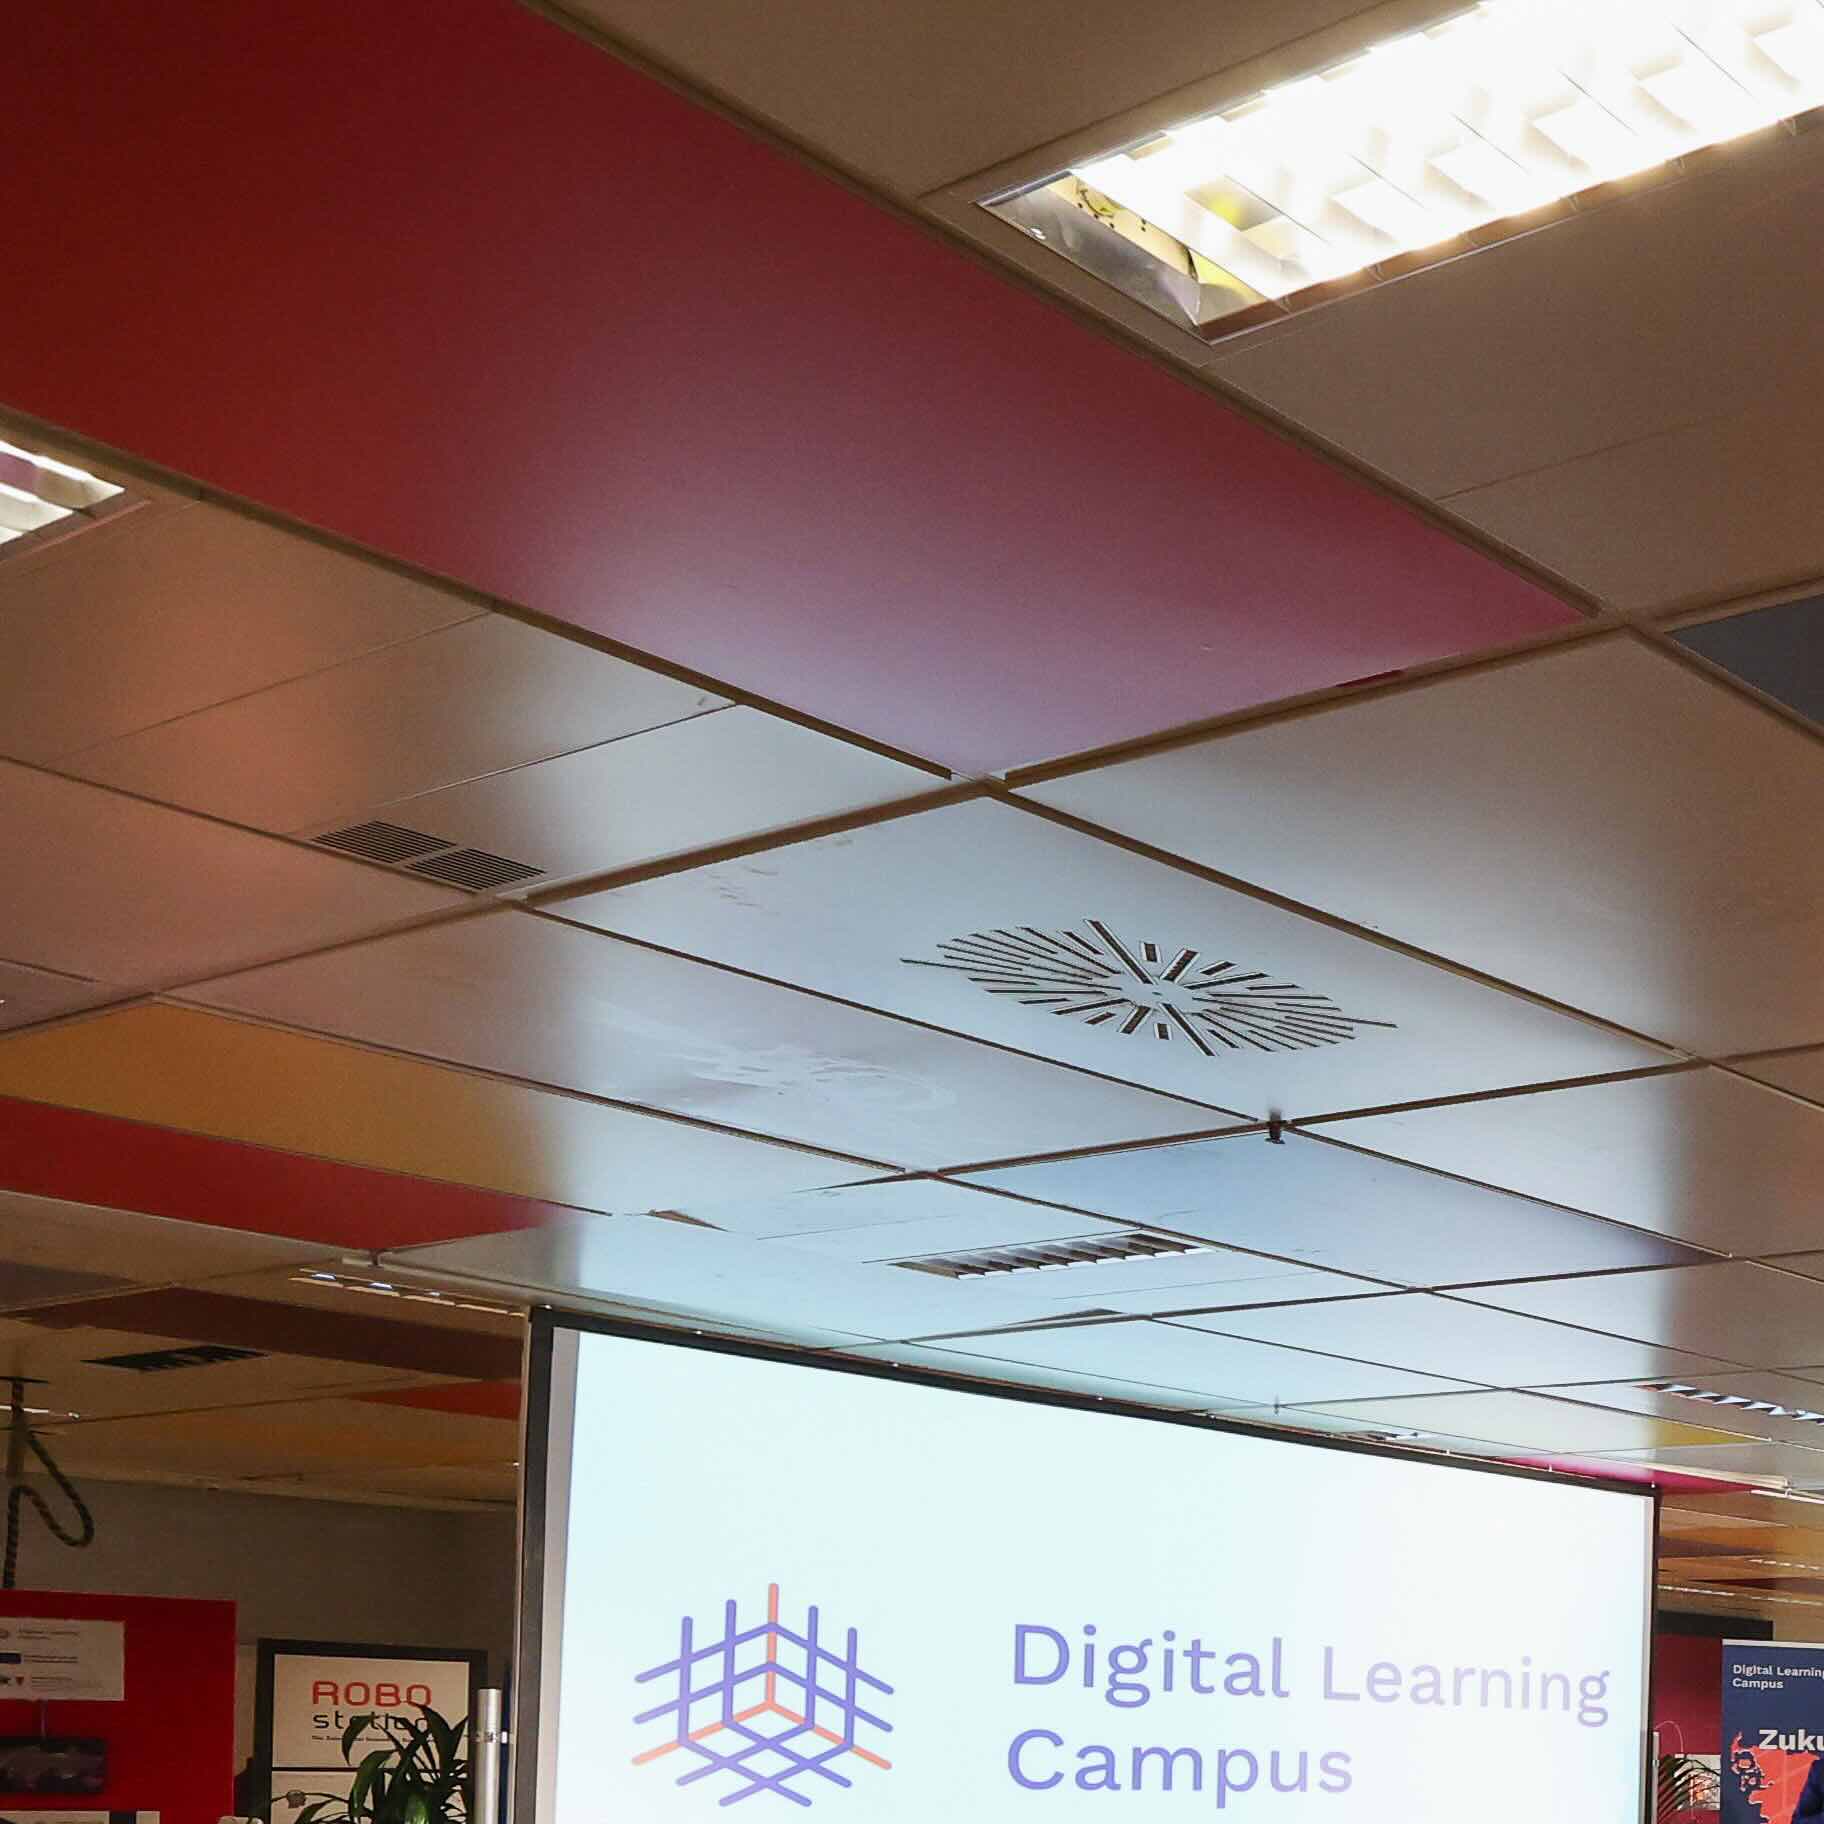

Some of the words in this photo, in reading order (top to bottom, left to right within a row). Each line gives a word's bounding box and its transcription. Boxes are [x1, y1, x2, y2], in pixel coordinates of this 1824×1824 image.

[1013, 1623, 1290, 1708] Digital
[1322, 1645, 1611, 1728] Learning
[1732, 1677, 1784, 1690] Campus
[1733, 1664, 1772, 1677] Digital
[312, 1680, 432, 1707] ROBO
[1007, 1728, 1354, 1809] Campus
